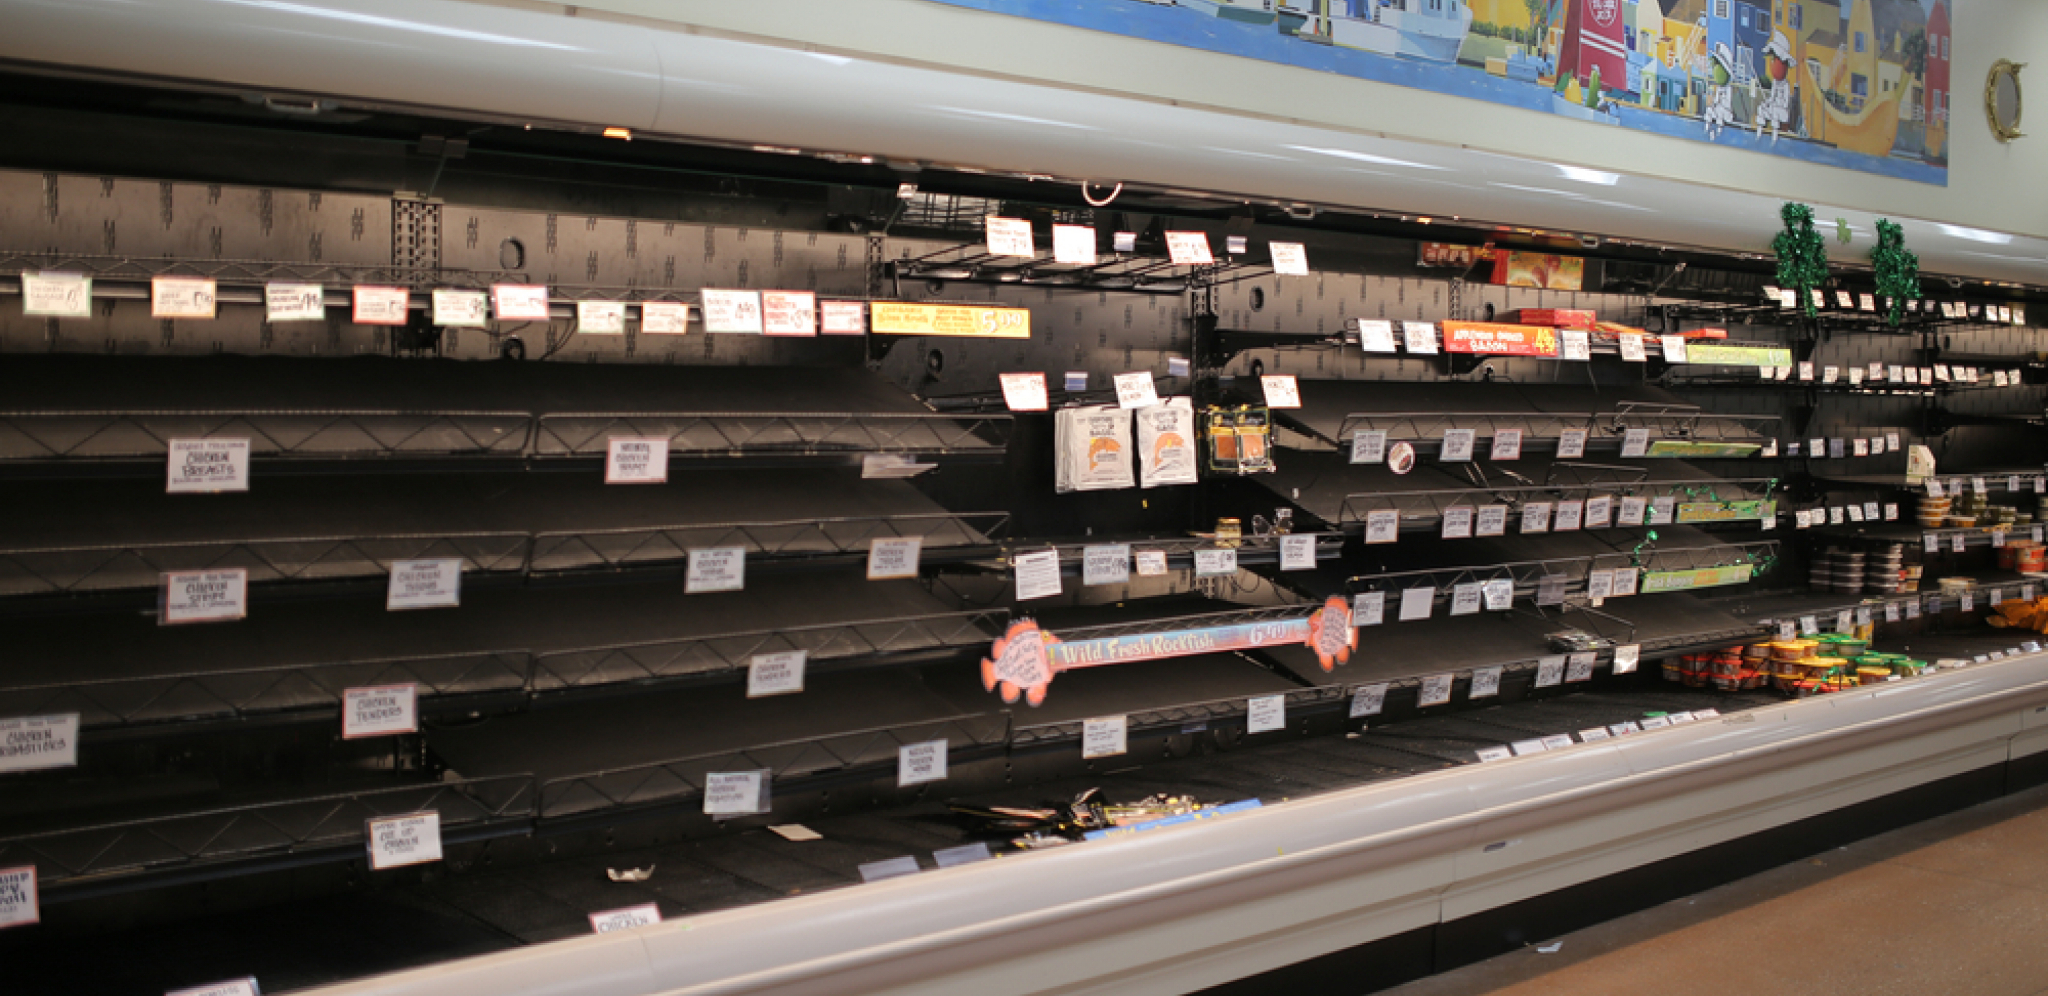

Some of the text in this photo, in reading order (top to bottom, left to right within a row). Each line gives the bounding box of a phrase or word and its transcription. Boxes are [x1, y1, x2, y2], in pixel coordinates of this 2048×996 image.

[1470, 340, 1508, 352] BACON
[186, 450, 230, 465] CHICKEN
[181, 463, 236, 477] BREASTS
[396, 569, 441, 583] CHICKEN
[186, 580, 229, 595] CHICKEN
[1060, 641, 1102, 664] Wild
[1106, 638, 1150, 659] Fresh
[1152, 632, 1215, 655] Rockfish
[356, 696, 397, 710] CHICKEN
[355, 705, 403, 723] TENDERS
[6, 727, 53, 746] CHICKEN
[382, 836, 420, 852] CHICKEN
[597, 915, 649, 934] CHICKEN
